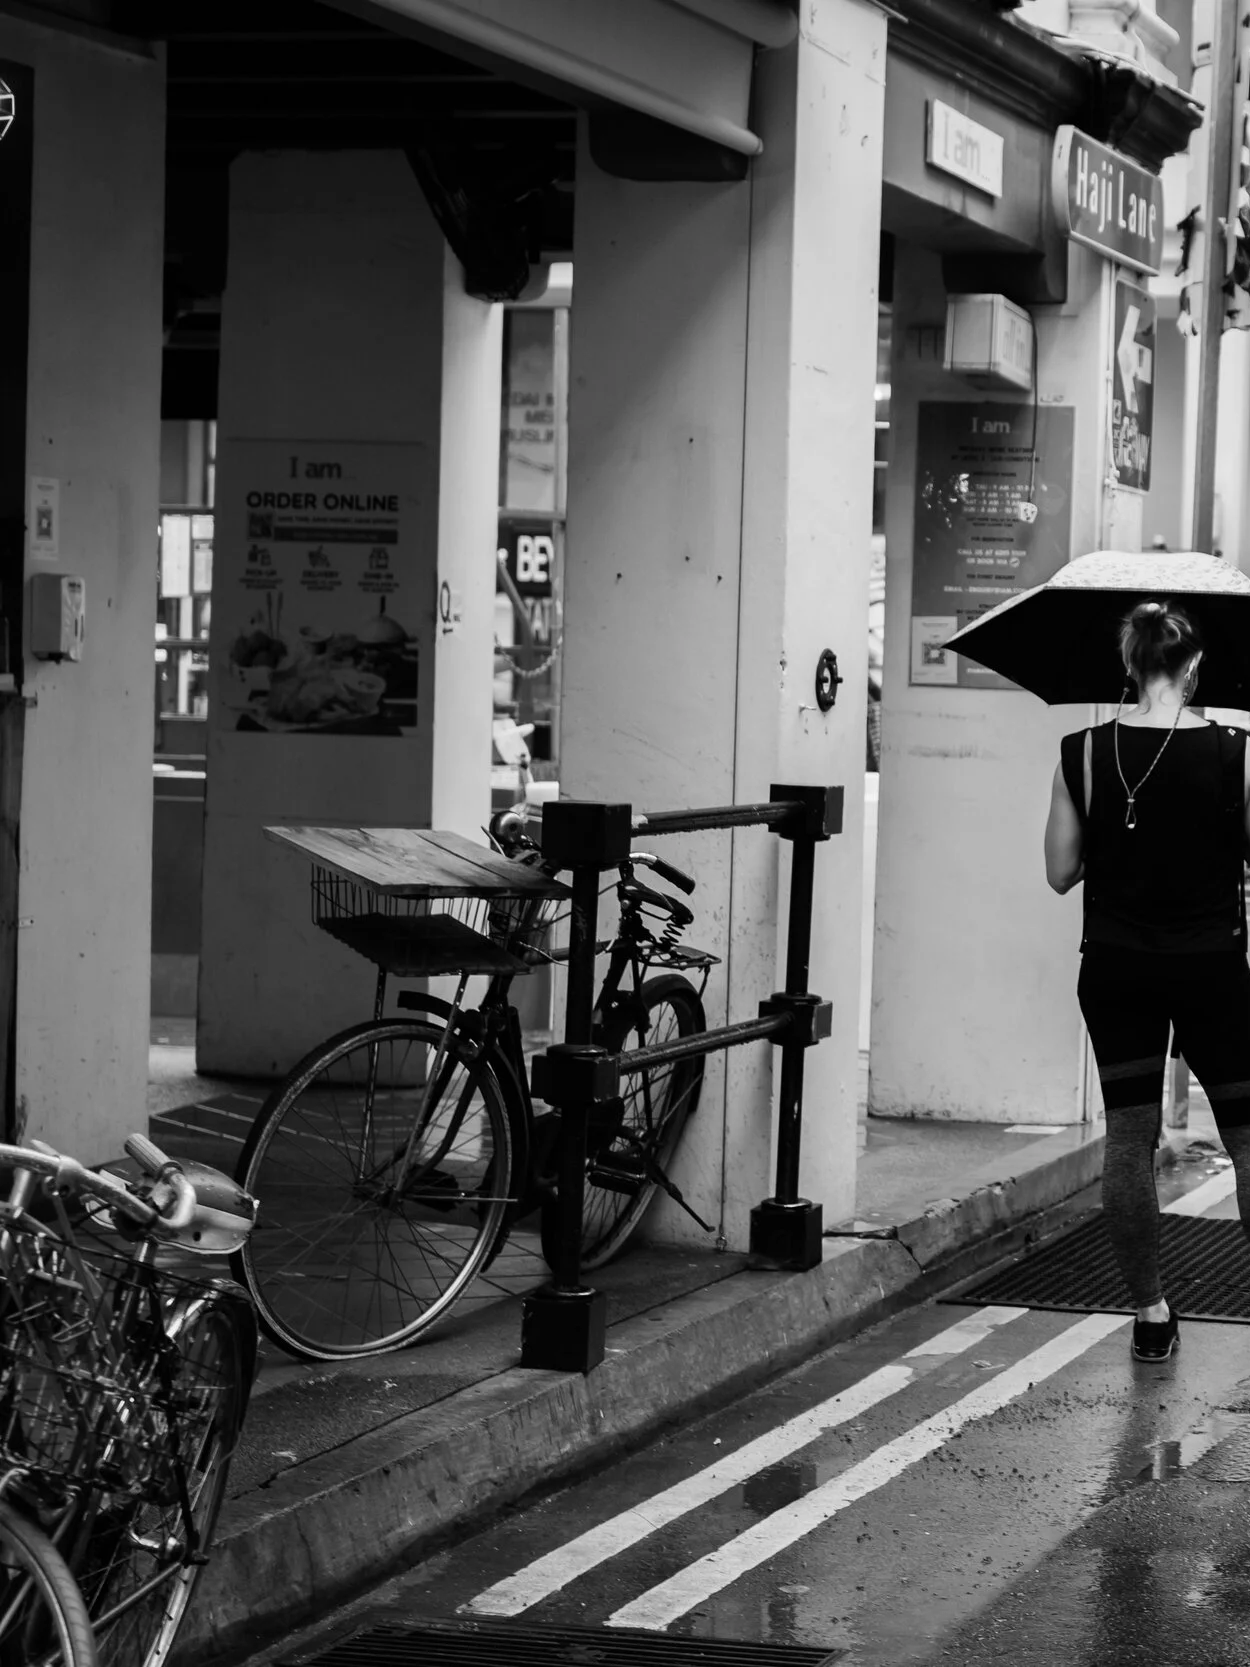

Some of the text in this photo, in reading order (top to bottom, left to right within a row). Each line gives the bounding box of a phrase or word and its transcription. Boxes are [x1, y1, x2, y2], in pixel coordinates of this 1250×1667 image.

[1075, 146, 1157, 244] Haji Lane
[246, 491, 399, 512] ORDER ONLINE
[516, 535, 555, 581] BE
